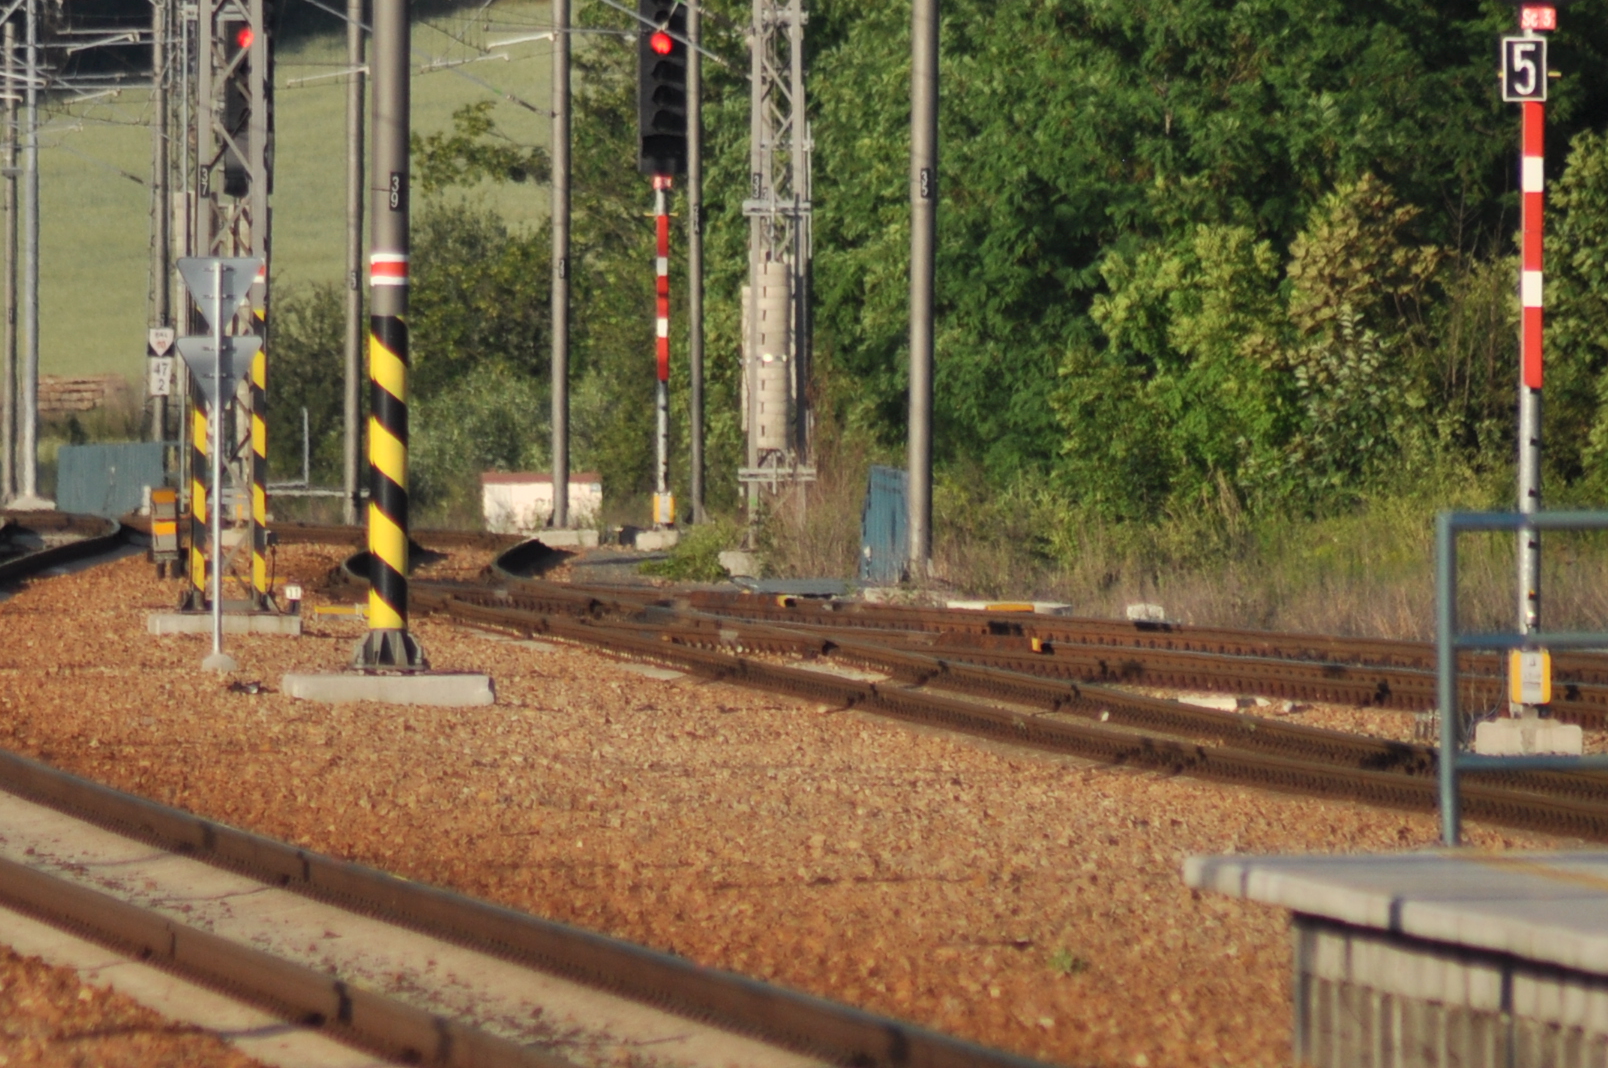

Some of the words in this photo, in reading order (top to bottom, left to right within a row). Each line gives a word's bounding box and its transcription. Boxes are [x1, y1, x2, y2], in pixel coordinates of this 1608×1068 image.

[1513, 42, 1536, 96] 5
[391, 175, 400, 208] 39
[154, 362, 169, 377] 47
[158, 378, 166, 392] 2
